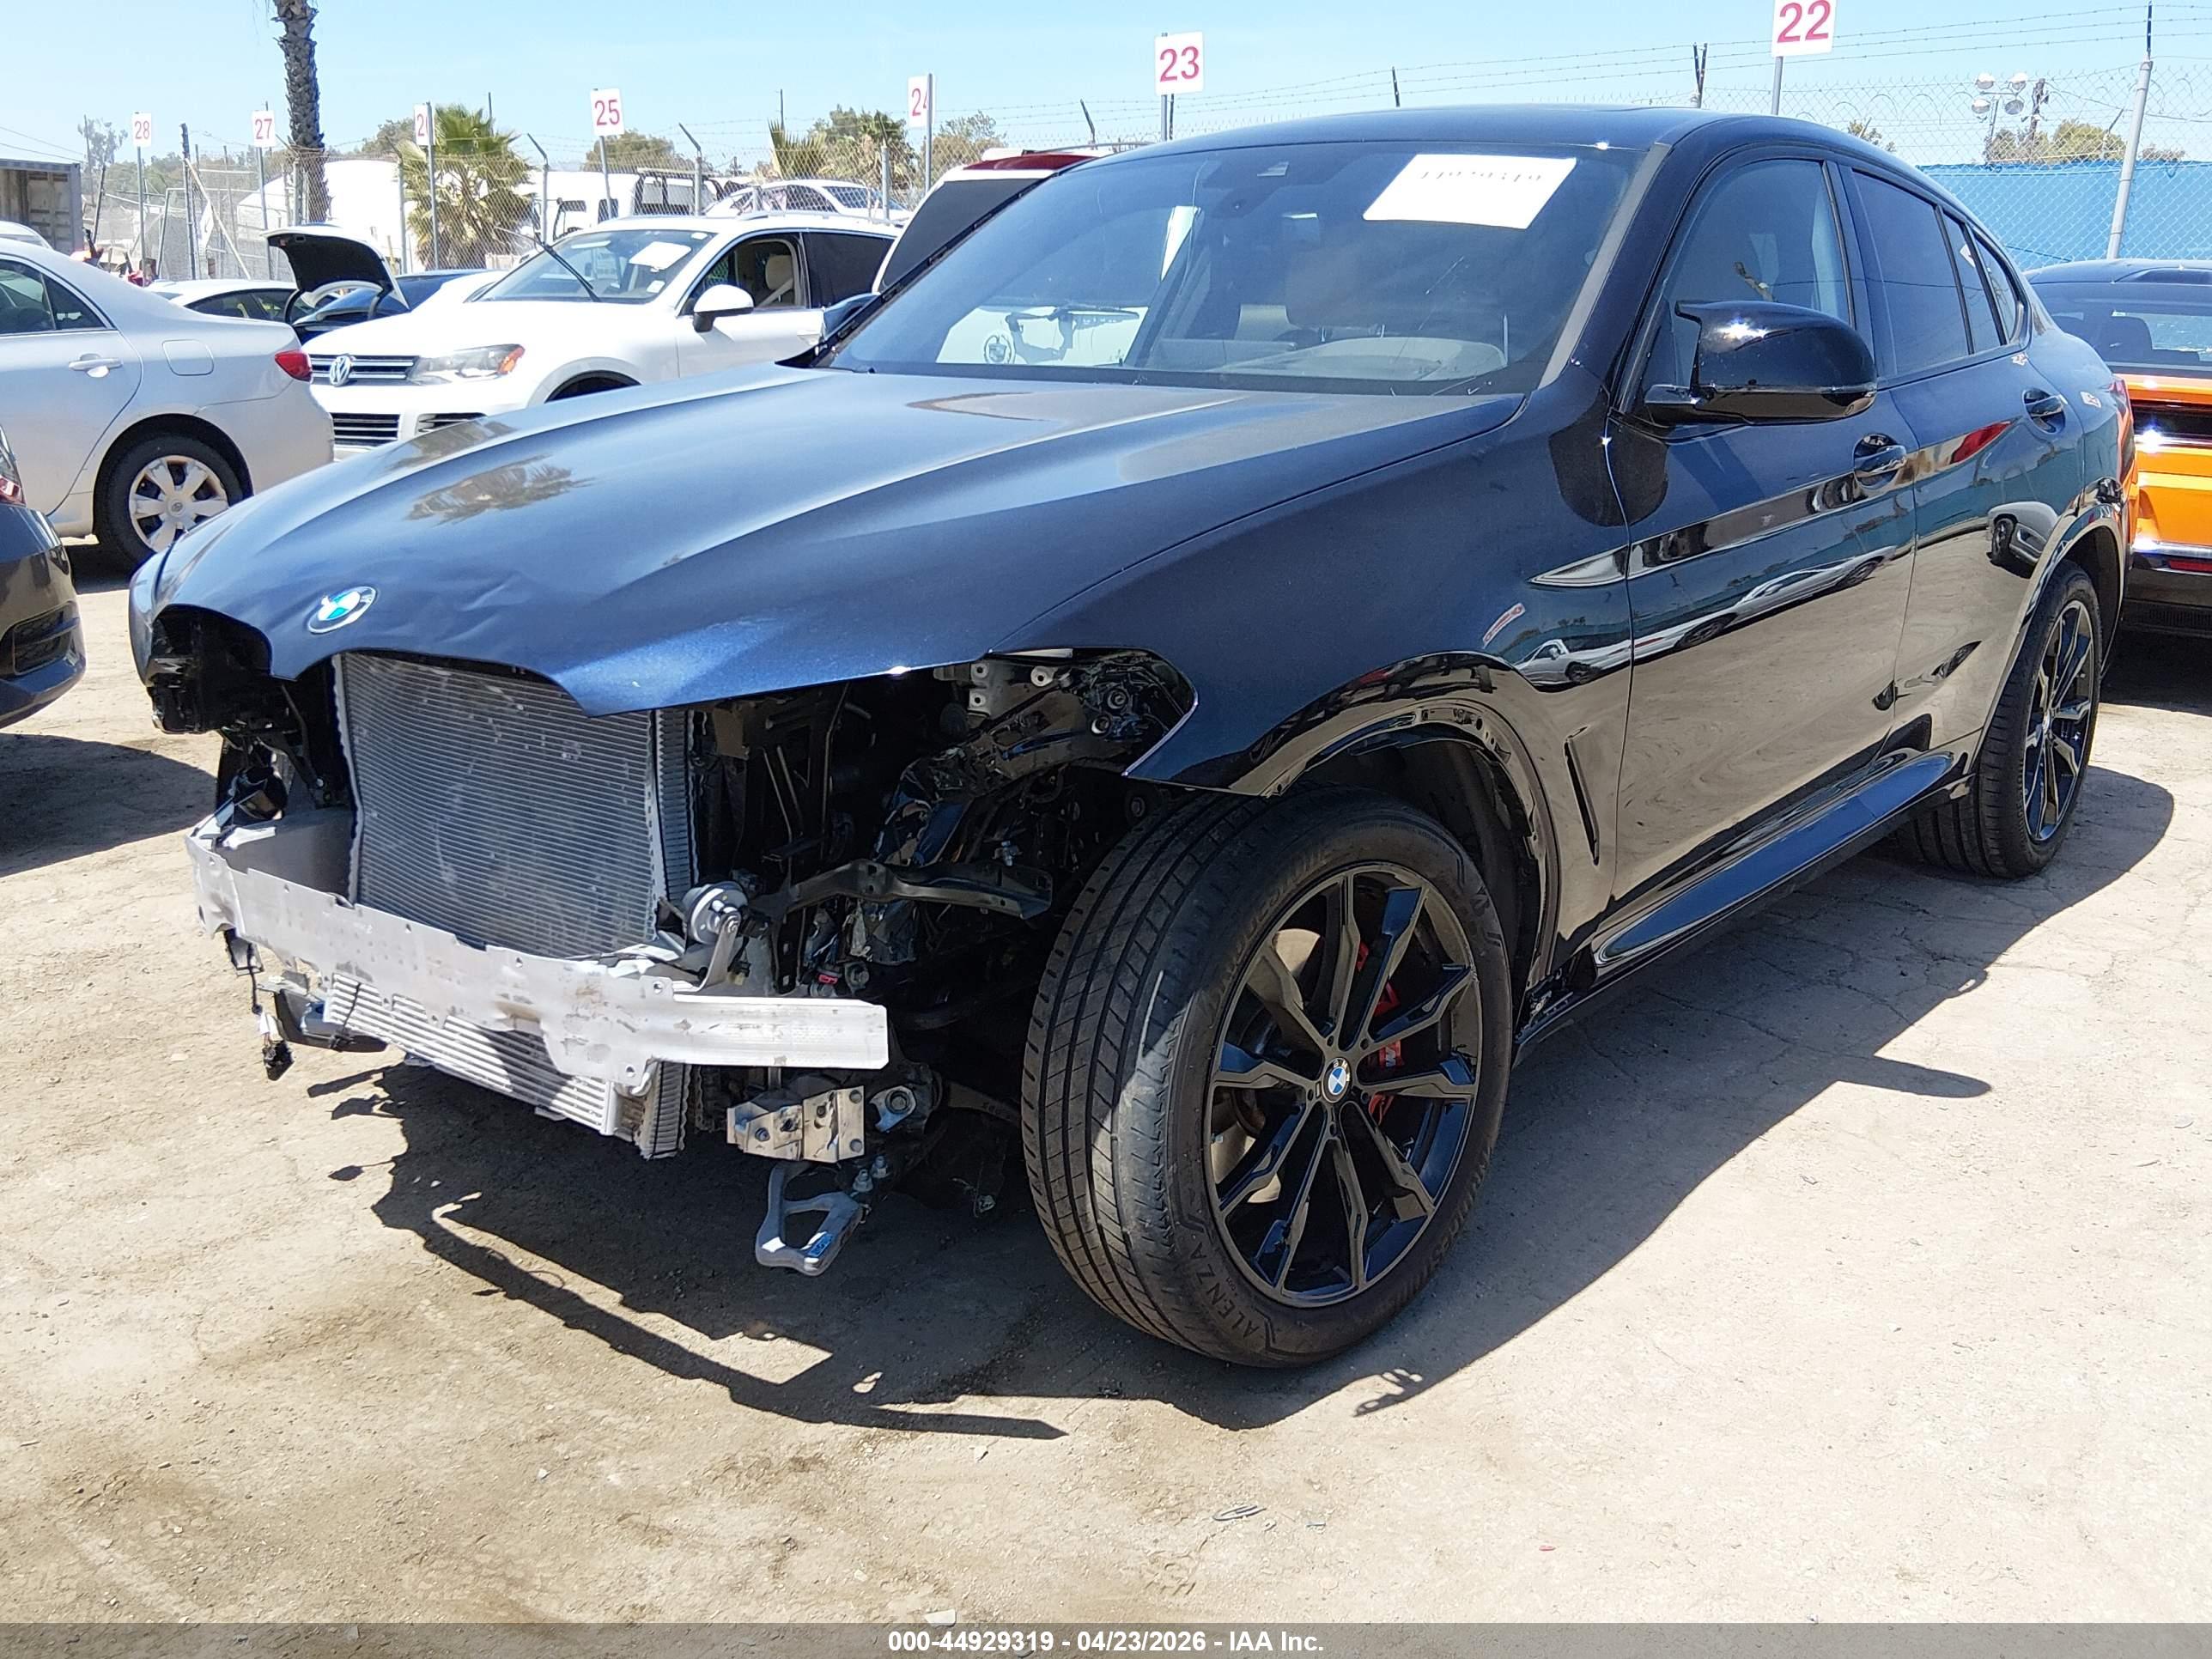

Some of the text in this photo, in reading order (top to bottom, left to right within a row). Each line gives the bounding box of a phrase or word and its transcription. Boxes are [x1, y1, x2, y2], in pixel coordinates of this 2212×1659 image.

[1777, 0, 1831, 43] 22
[1159, 46, 1200, 82] 23
[416, 113, 428, 137] 2
[594, 99, 620, 125] 25
[134, 120, 150, 140] 28
[254, 118, 272, 140] 27
[1188, 1242, 1261, 1338] ALENZA
